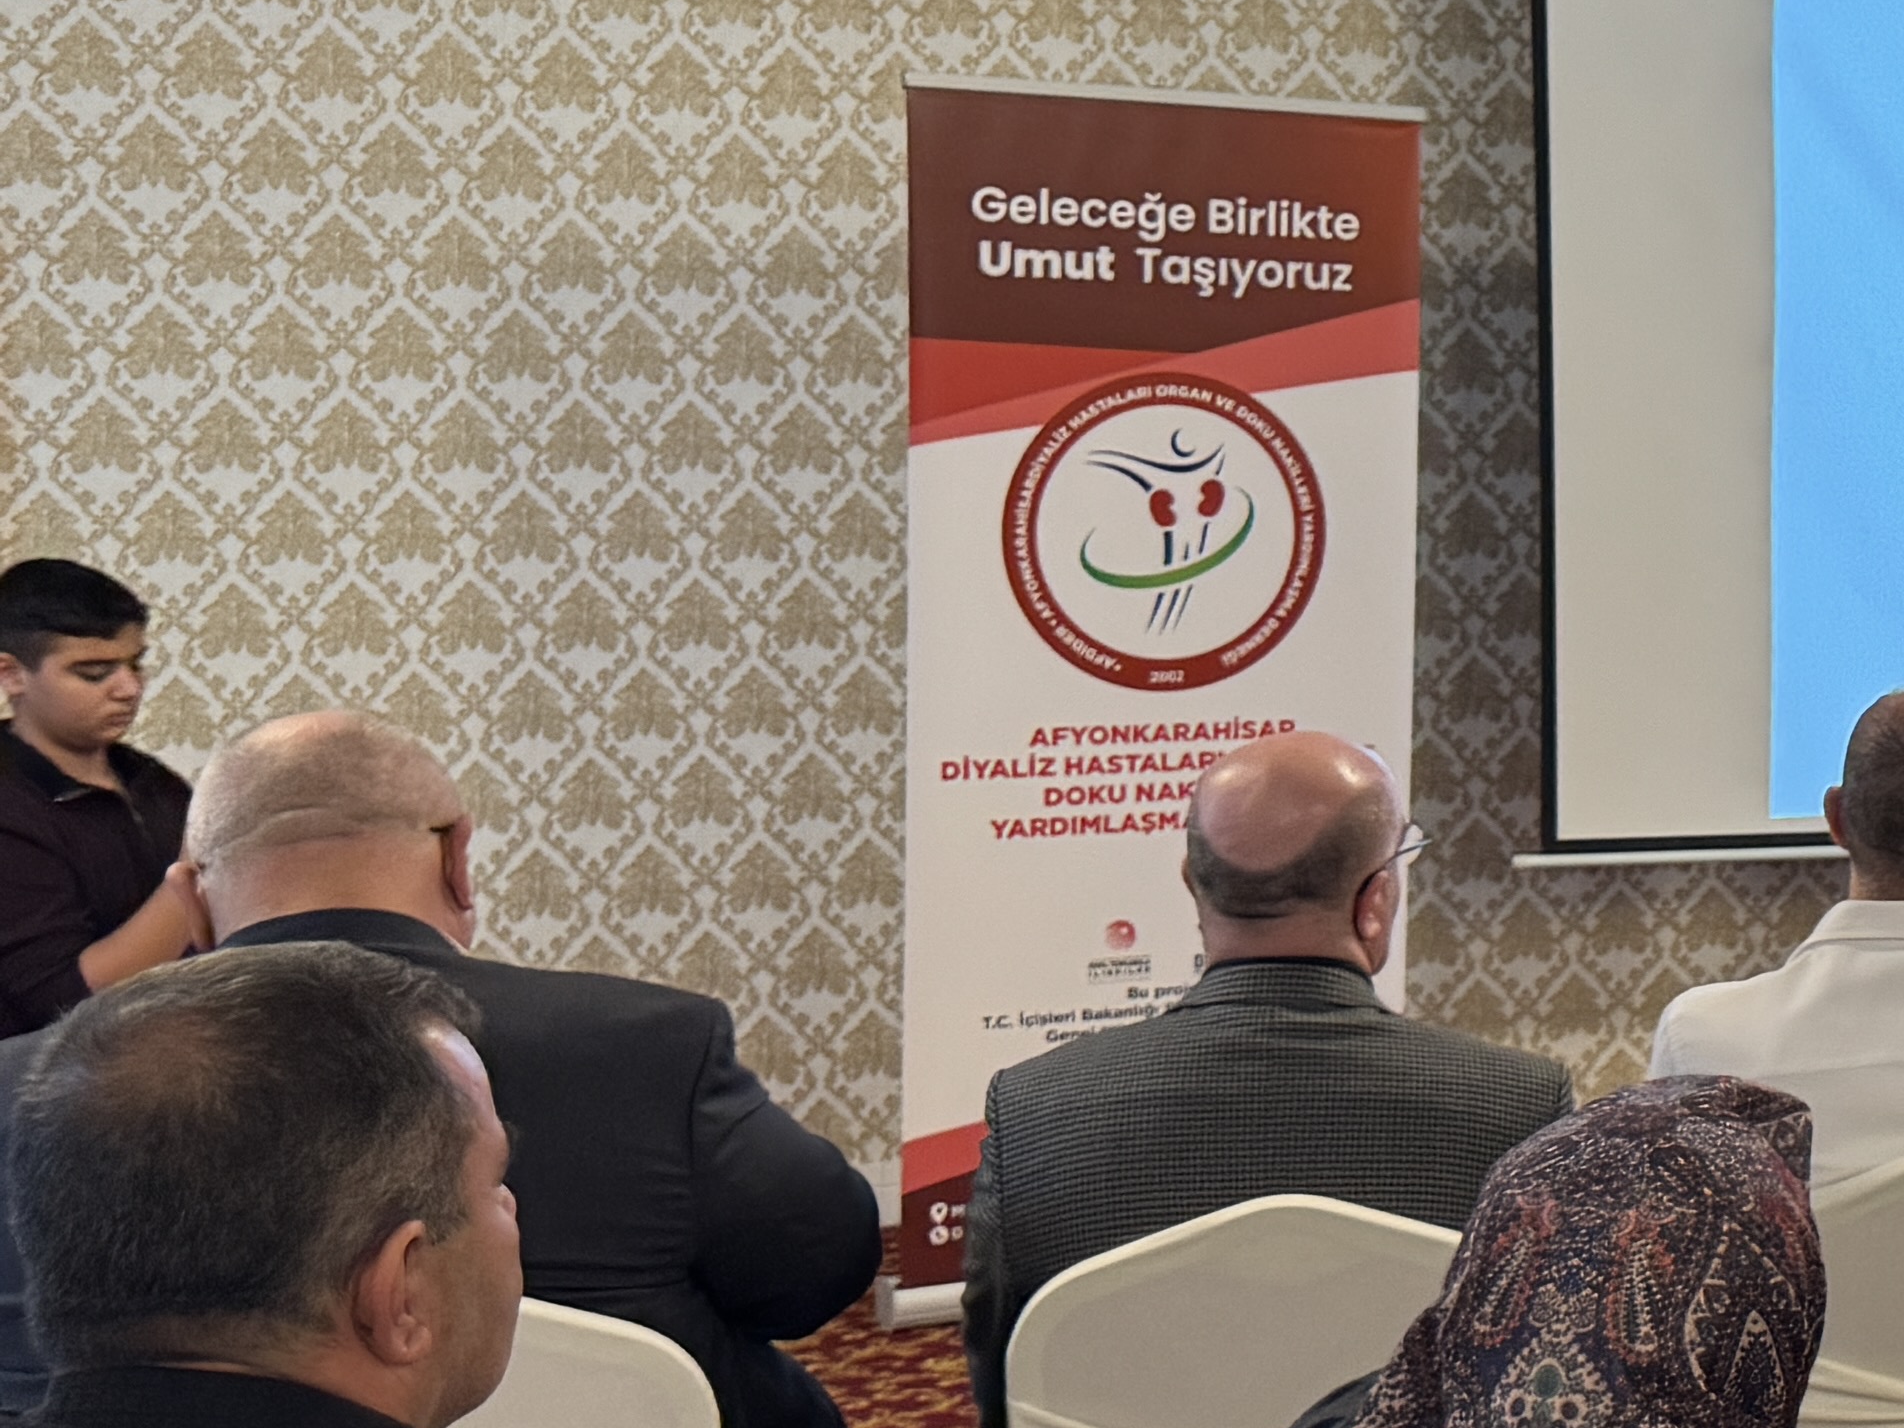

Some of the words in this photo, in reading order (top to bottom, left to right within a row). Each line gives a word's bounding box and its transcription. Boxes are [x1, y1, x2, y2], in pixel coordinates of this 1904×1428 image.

[971, 186, 1195, 242] Geleceğe
[1207, 197, 1360, 241] Birlikte
[979, 240, 1116, 281] Umut
[1135, 246, 1353, 299] Taşıyoruz
[1155, 383, 1214, 404] ORGAN
[1212, 393, 1236, 413] VE
[1233, 403, 1277, 442] DOKU
[940, 755, 1057, 782] DİYALİZ
[1064, 750, 1224, 776] HASTALAR
[1043, 782, 1127, 808] DOKU
